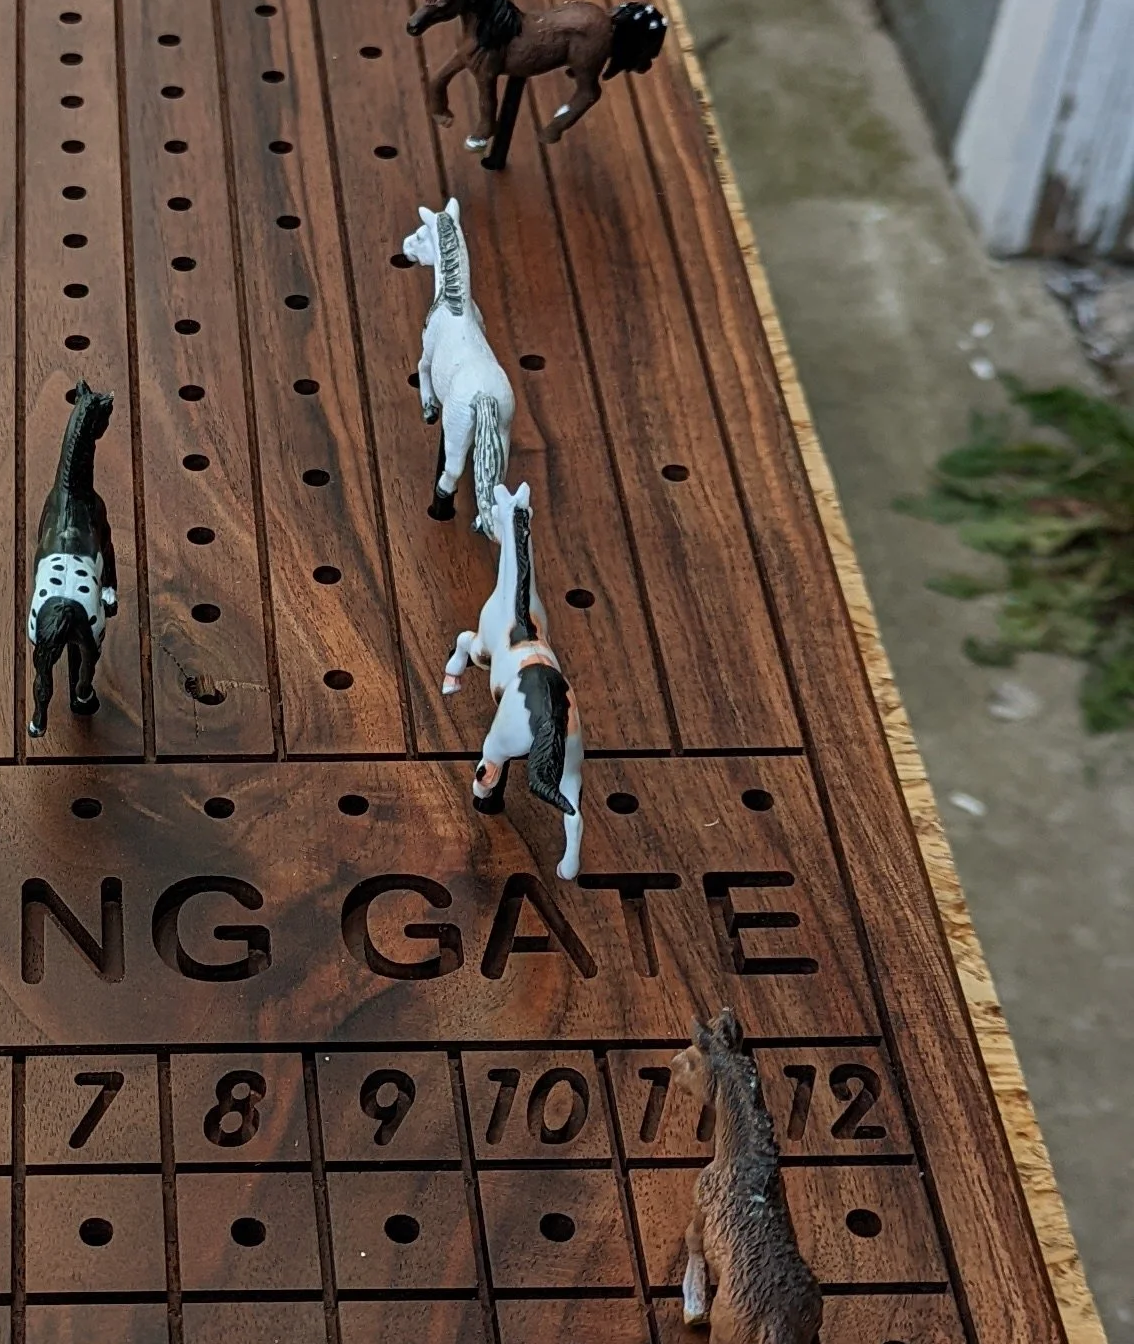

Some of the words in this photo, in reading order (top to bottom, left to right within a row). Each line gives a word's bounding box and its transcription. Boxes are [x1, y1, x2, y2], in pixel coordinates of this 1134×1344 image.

[340, 870, 820, 981] GATE
[69, 1071, 125, 1149] 7
[203, 1070, 267, 1149] 8
[359, 1069, 417, 1147] 9
[485, 1067, 591, 1145] 10
[783, 1063, 888, 1141] 12
